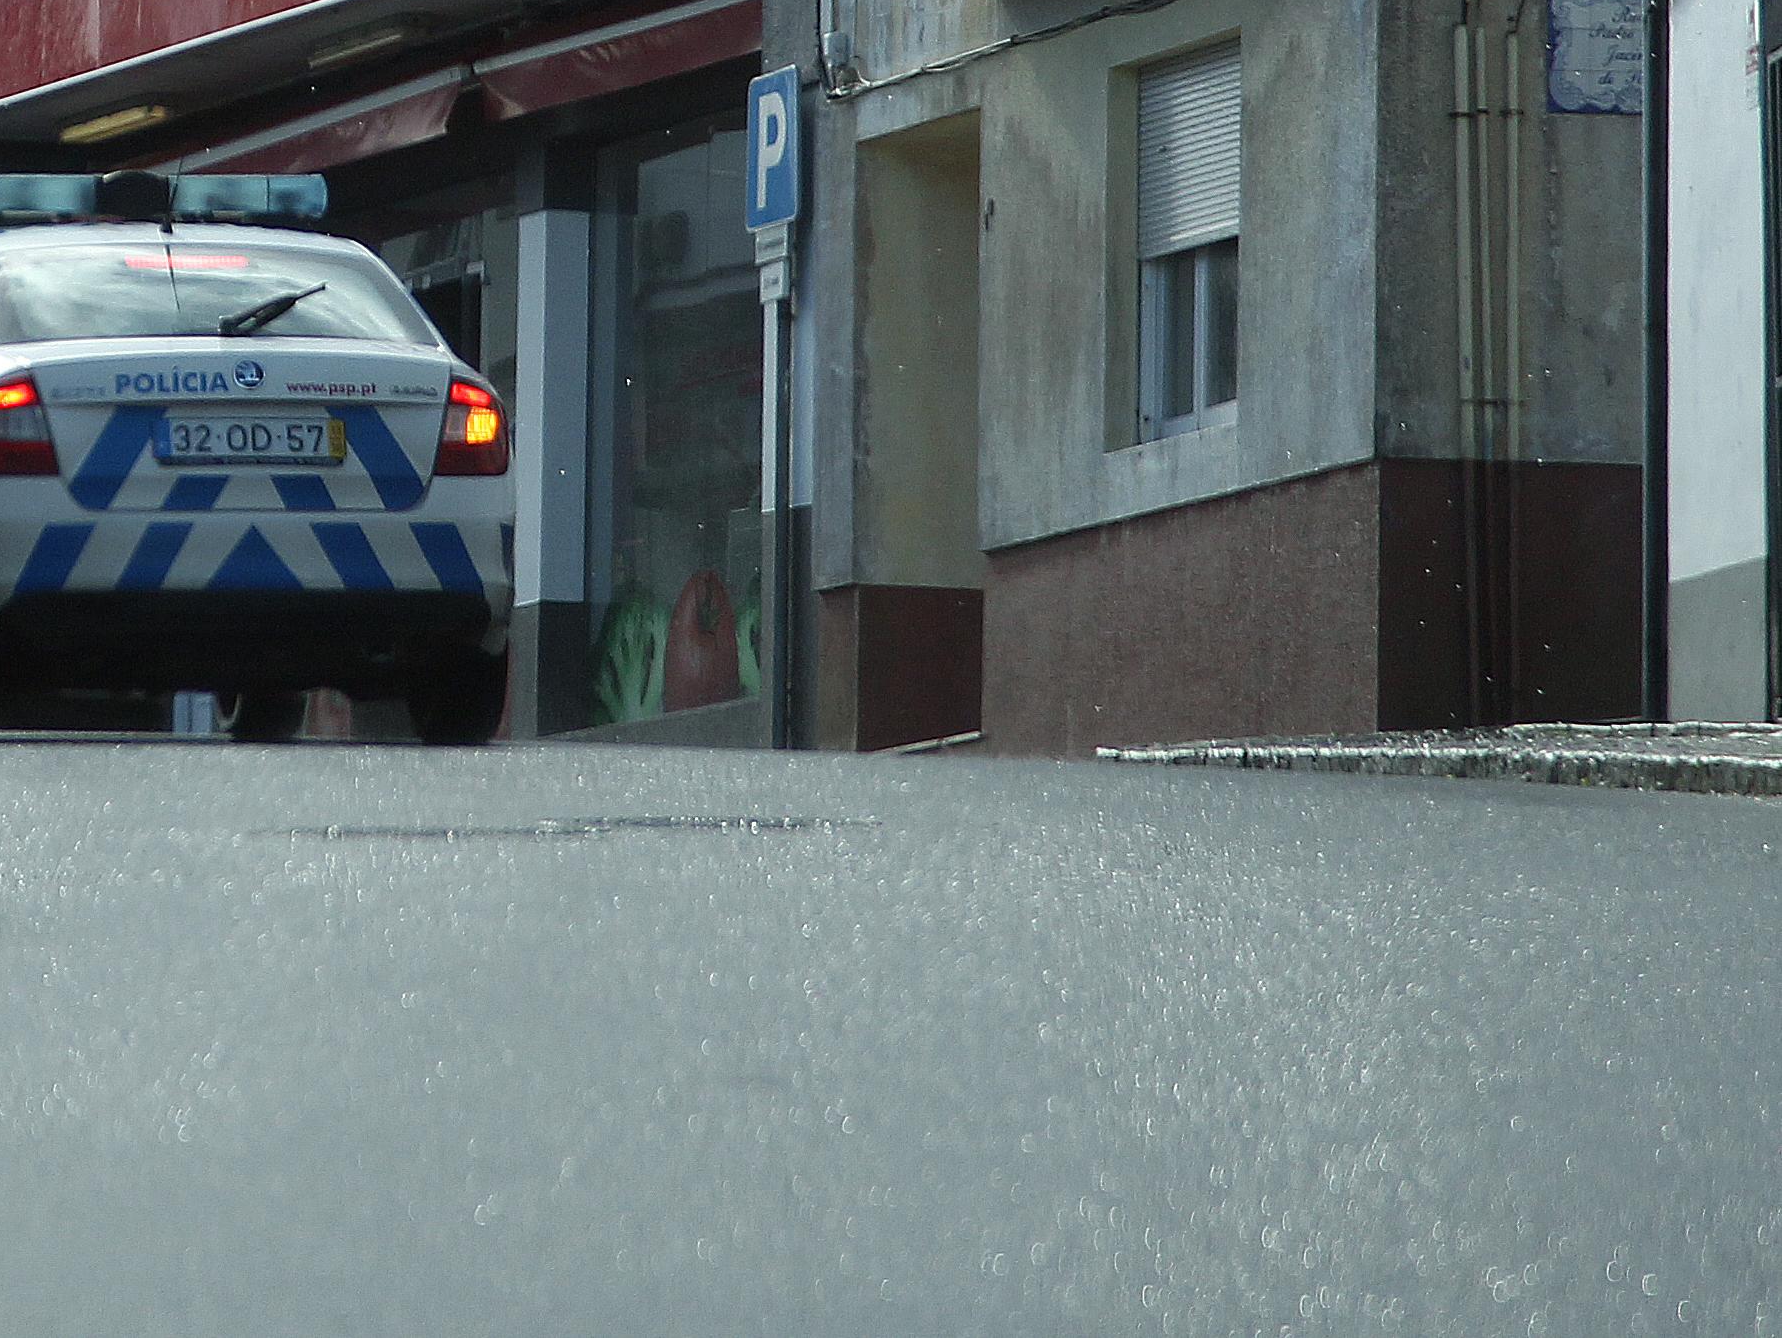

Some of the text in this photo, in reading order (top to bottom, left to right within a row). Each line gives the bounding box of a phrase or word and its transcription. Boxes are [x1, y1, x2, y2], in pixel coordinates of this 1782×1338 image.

[756, 91, 786, 209] P
[115, 366, 229, 394] POLÍCIA
[286, 381, 377, 396] www.psp.pt
